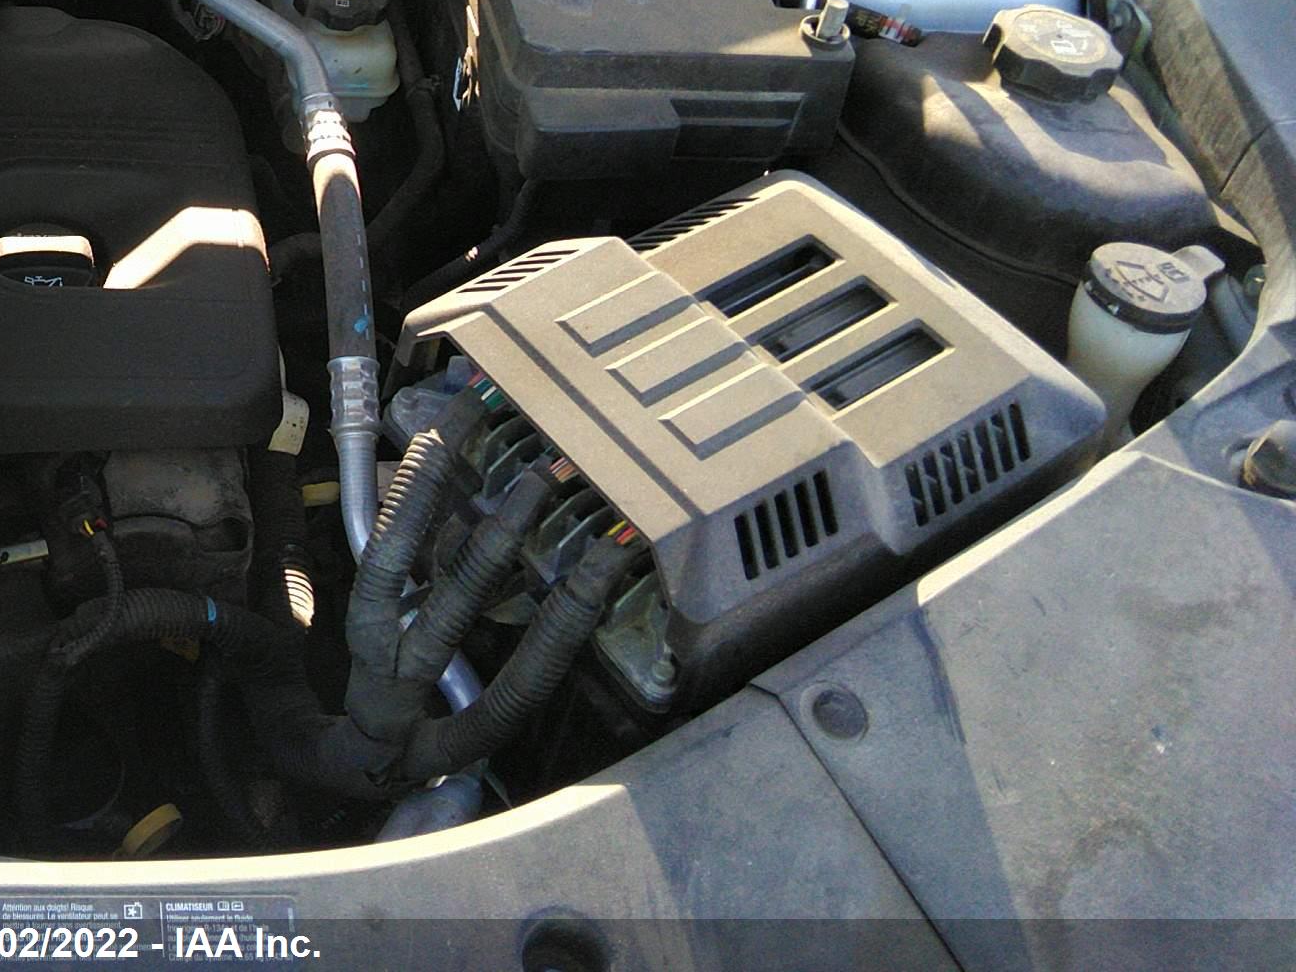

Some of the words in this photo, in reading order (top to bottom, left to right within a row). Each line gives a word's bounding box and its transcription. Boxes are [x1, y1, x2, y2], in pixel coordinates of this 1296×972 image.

[1, 903, 32, 912] Attention
[33, 904, 45, 912] aux
[165, 902, 214, 911] CLIMATISEUR
